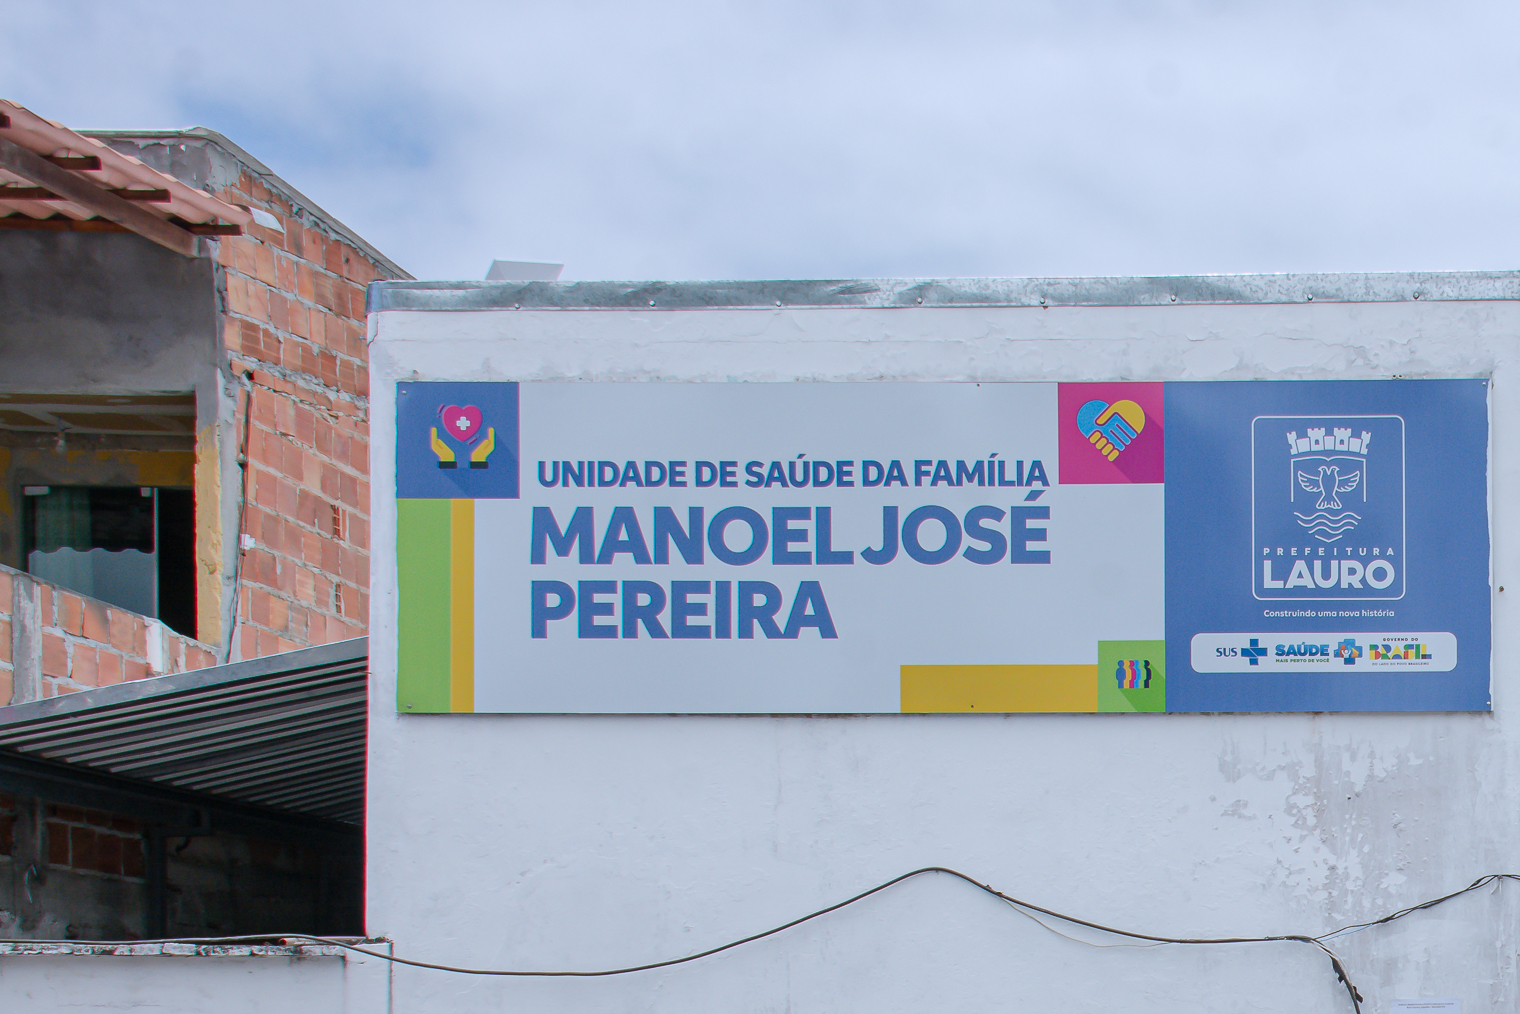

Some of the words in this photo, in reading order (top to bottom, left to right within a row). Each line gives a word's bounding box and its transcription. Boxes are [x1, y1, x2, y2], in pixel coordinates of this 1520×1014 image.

[537, 460, 687, 489] UNIDADE
[694, 460, 738, 488] DE
[744, 453, 855, 488] SAÚDE
[861, 460, 911, 488] DA
[913, 453, 1051, 487] FAMÍLIA
[530, 505, 854, 566] MANOEL
[859, 490, 1052, 566] JOSÉ
[1263, 547, 1395, 556] PREFEITURA
[1263, 559, 1396, 590] LAURO
[530, 579, 839, 640] PEREIRA
[1263, 609, 1317, 618] Construindo
[1361, 609, 1395, 618] história
[1215, 647, 1238, 658] SUS
[1274, 641, 1330, 657] SAÚDE
[1369, 643, 1433, 660] BRASIL
